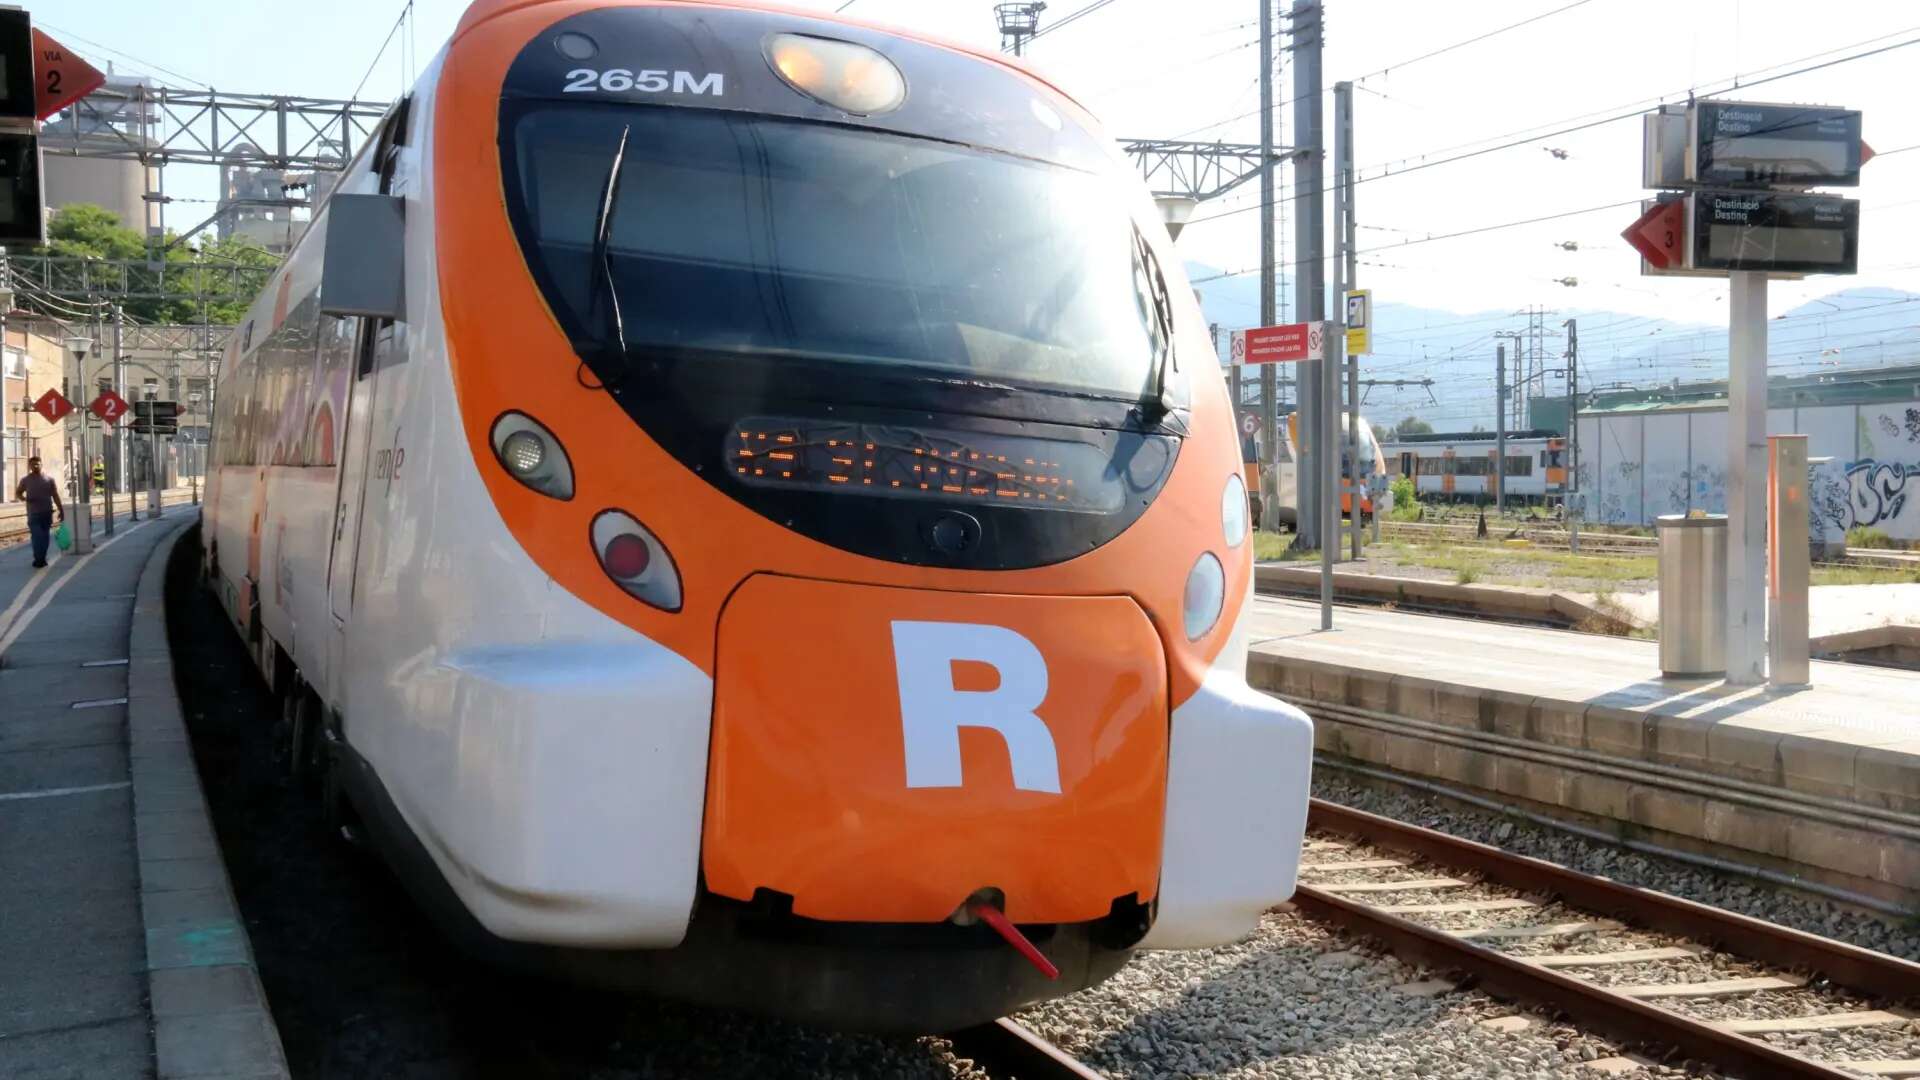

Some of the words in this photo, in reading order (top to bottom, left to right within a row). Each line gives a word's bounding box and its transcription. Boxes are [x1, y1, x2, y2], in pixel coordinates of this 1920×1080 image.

[48, 70, 62, 94] 2
[563, 68, 723, 96] 265M
[1718, 121, 1751, 132] Destino
[1715, 198, 1759, 210] Destinació
[1715, 210, 1748, 221] Destino
[1664, 230, 1674, 249] 3
[48, 398, 57, 416] 1
[105, 399, 117, 417] 2
[1243, 415, 1255, 433] 6
[890, 619, 1063, 795] R
